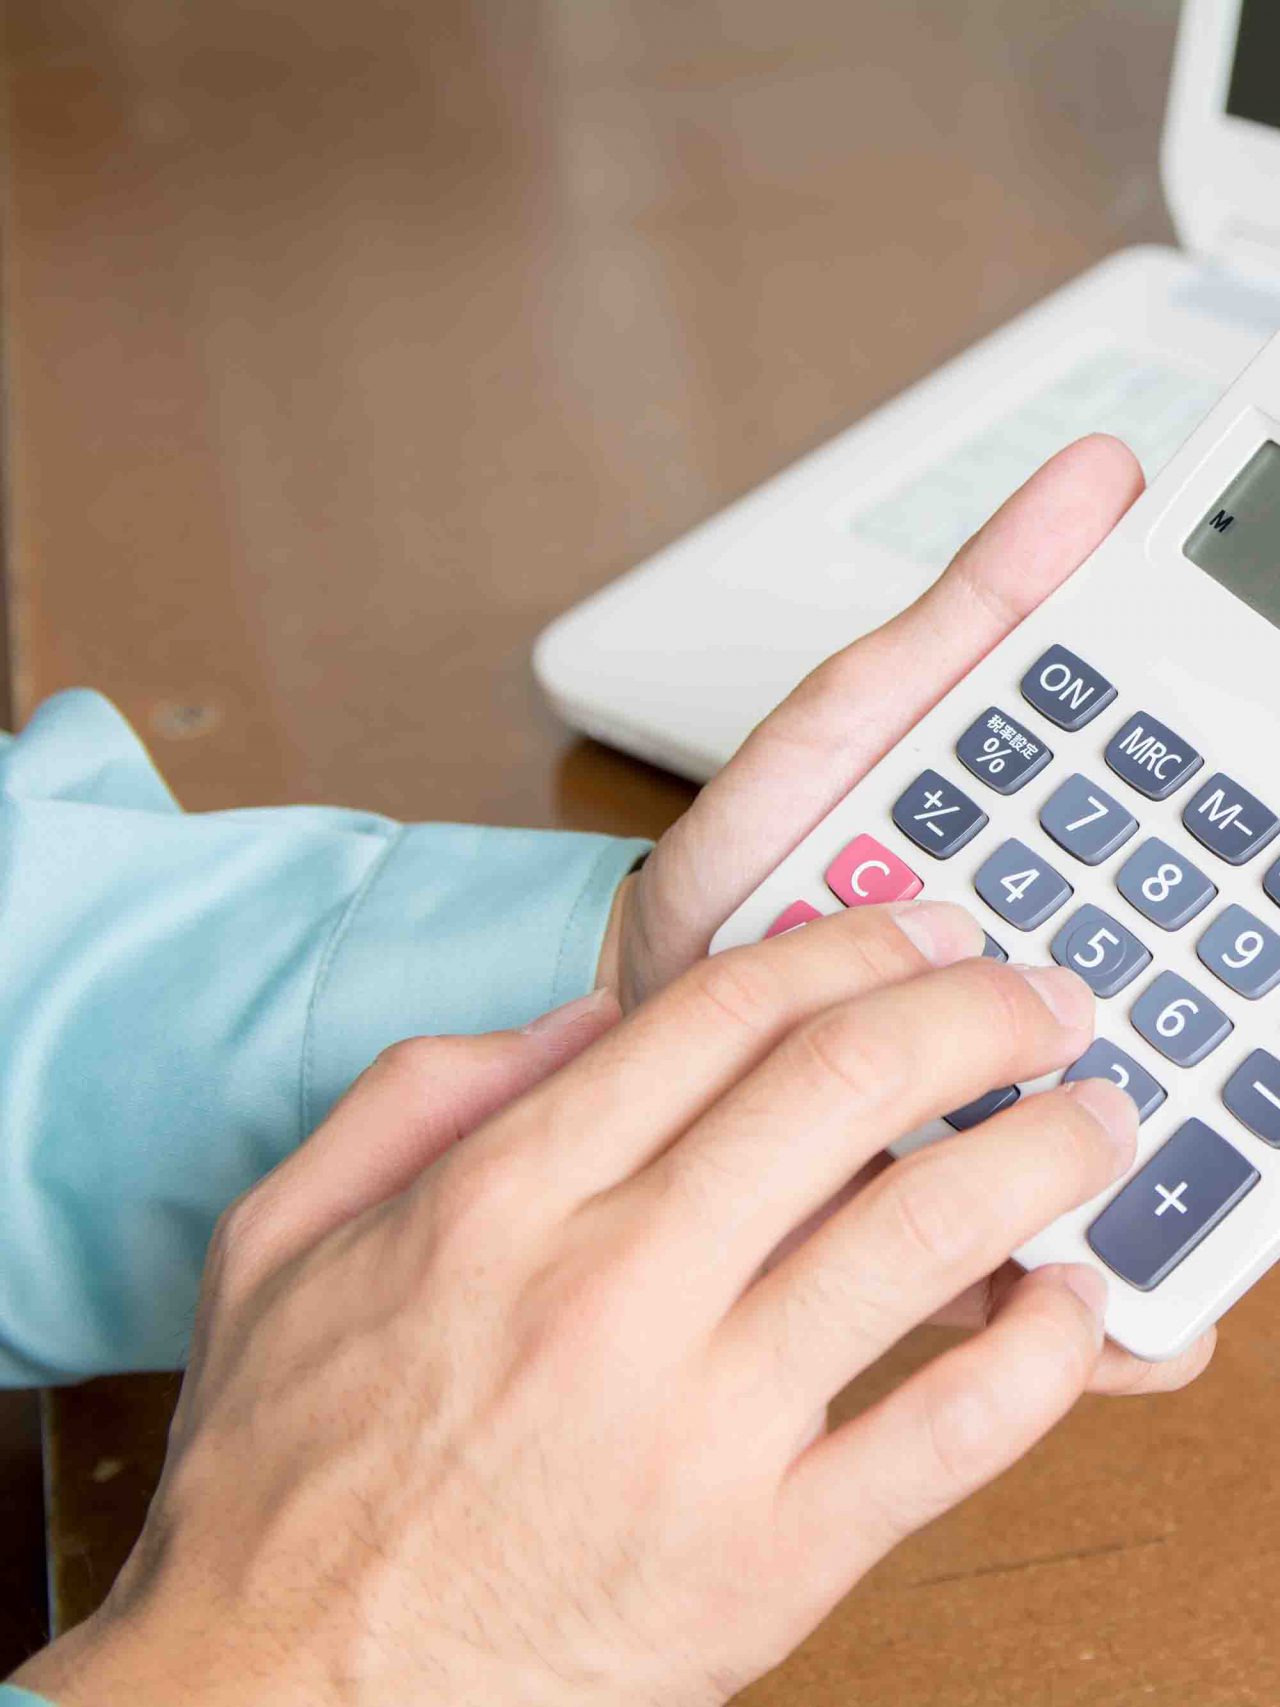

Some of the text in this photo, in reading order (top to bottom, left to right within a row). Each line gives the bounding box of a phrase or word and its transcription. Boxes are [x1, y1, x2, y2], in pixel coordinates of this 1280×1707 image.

[1208, 509, 1232, 533] M
[1039, 663, 1095, 710] ON
[986, 714, 1039, 760] 税率設定
[1118, 726, 1183, 781] MRC
[1065, 796, 1109, 832] 7
[850, 859, 891, 897] C
[999, 867, 1041, 904] 4
[1141, 862, 1184, 903] 8
[1073, 927, 1120, 968] 5
[1221, 930, 1265, 969] 9
[1155, 998, 1199, 1038] 6
